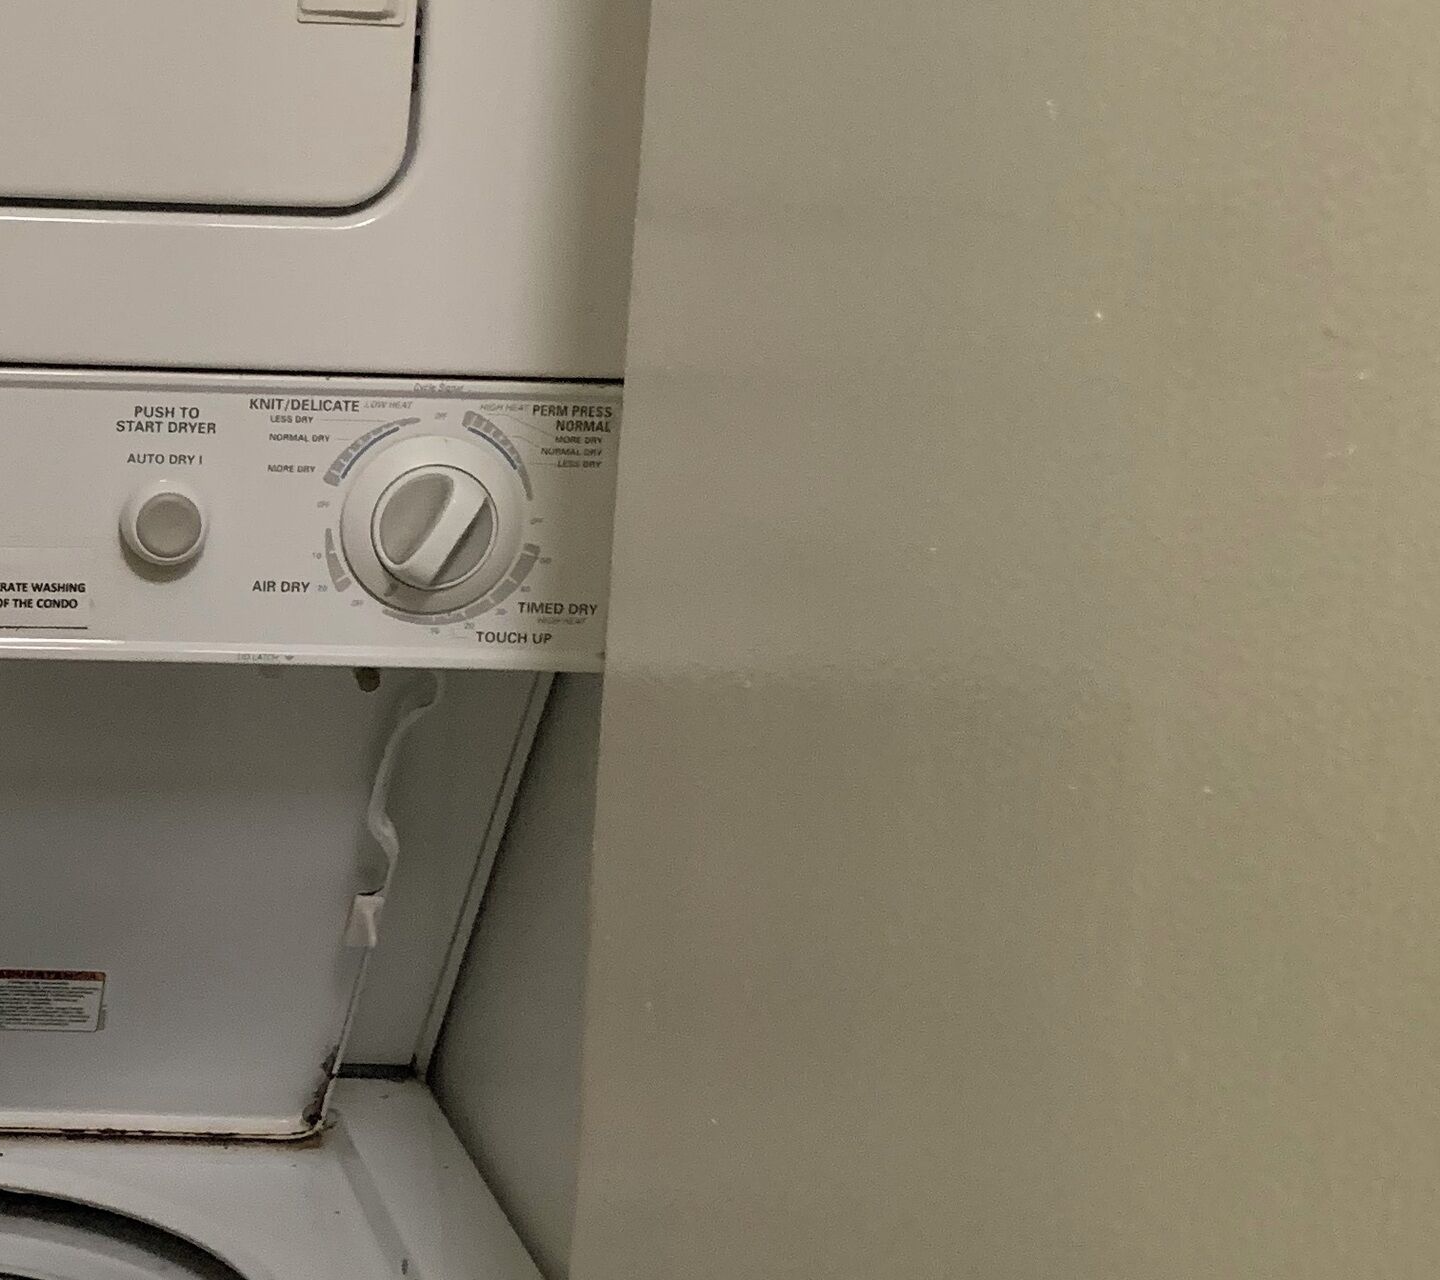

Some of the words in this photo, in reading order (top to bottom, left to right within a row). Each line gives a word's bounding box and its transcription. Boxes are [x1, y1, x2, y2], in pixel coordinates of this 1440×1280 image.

[249, 398, 360, 412] KNIT/DELICATE
[532, 404, 568, 417] PERM
[572, 405, 613, 418] PRESS
[134, 406, 175, 418] PUSH
[180, 407, 200, 419] TO
[270, 415, 293, 424] LESS
[295, 416, 314, 424] DRY
[116, 420, 163, 433] START
[168, 422, 217, 434] DRYER
[555, 420, 611, 433] NORMAL
[269, 433, 310, 442] NORMAL
[312, 434, 330, 443] DRY
[555, 436, 581, 444] MORE
[584, 436, 602, 444] DRY
[541, 447, 580, 456] NORMAL
[584, 448, 602, 456] DRY
[127, 453, 165, 465] AUTO
[169, 454, 195, 465] DRY
[557, 460, 579, 468] LESS
[583, 460, 602, 468] DRY
[267, 464, 294, 473] MORE
[297, 465, 316, 473] DRY
[31, 582, 86, 593] WASHING
[252, 581, 276, 592] AIR
[281, 581, 310, 593] DRY
[12, 598, 33, 608] THE
[36, 599, 78, 609] CONDO
[518, 601, 564, 614] TIMED
[568, 603, 598, 615] DRY
[476, 631, 528, 644] TOUCH
[532, 633, 552, 644] UP
